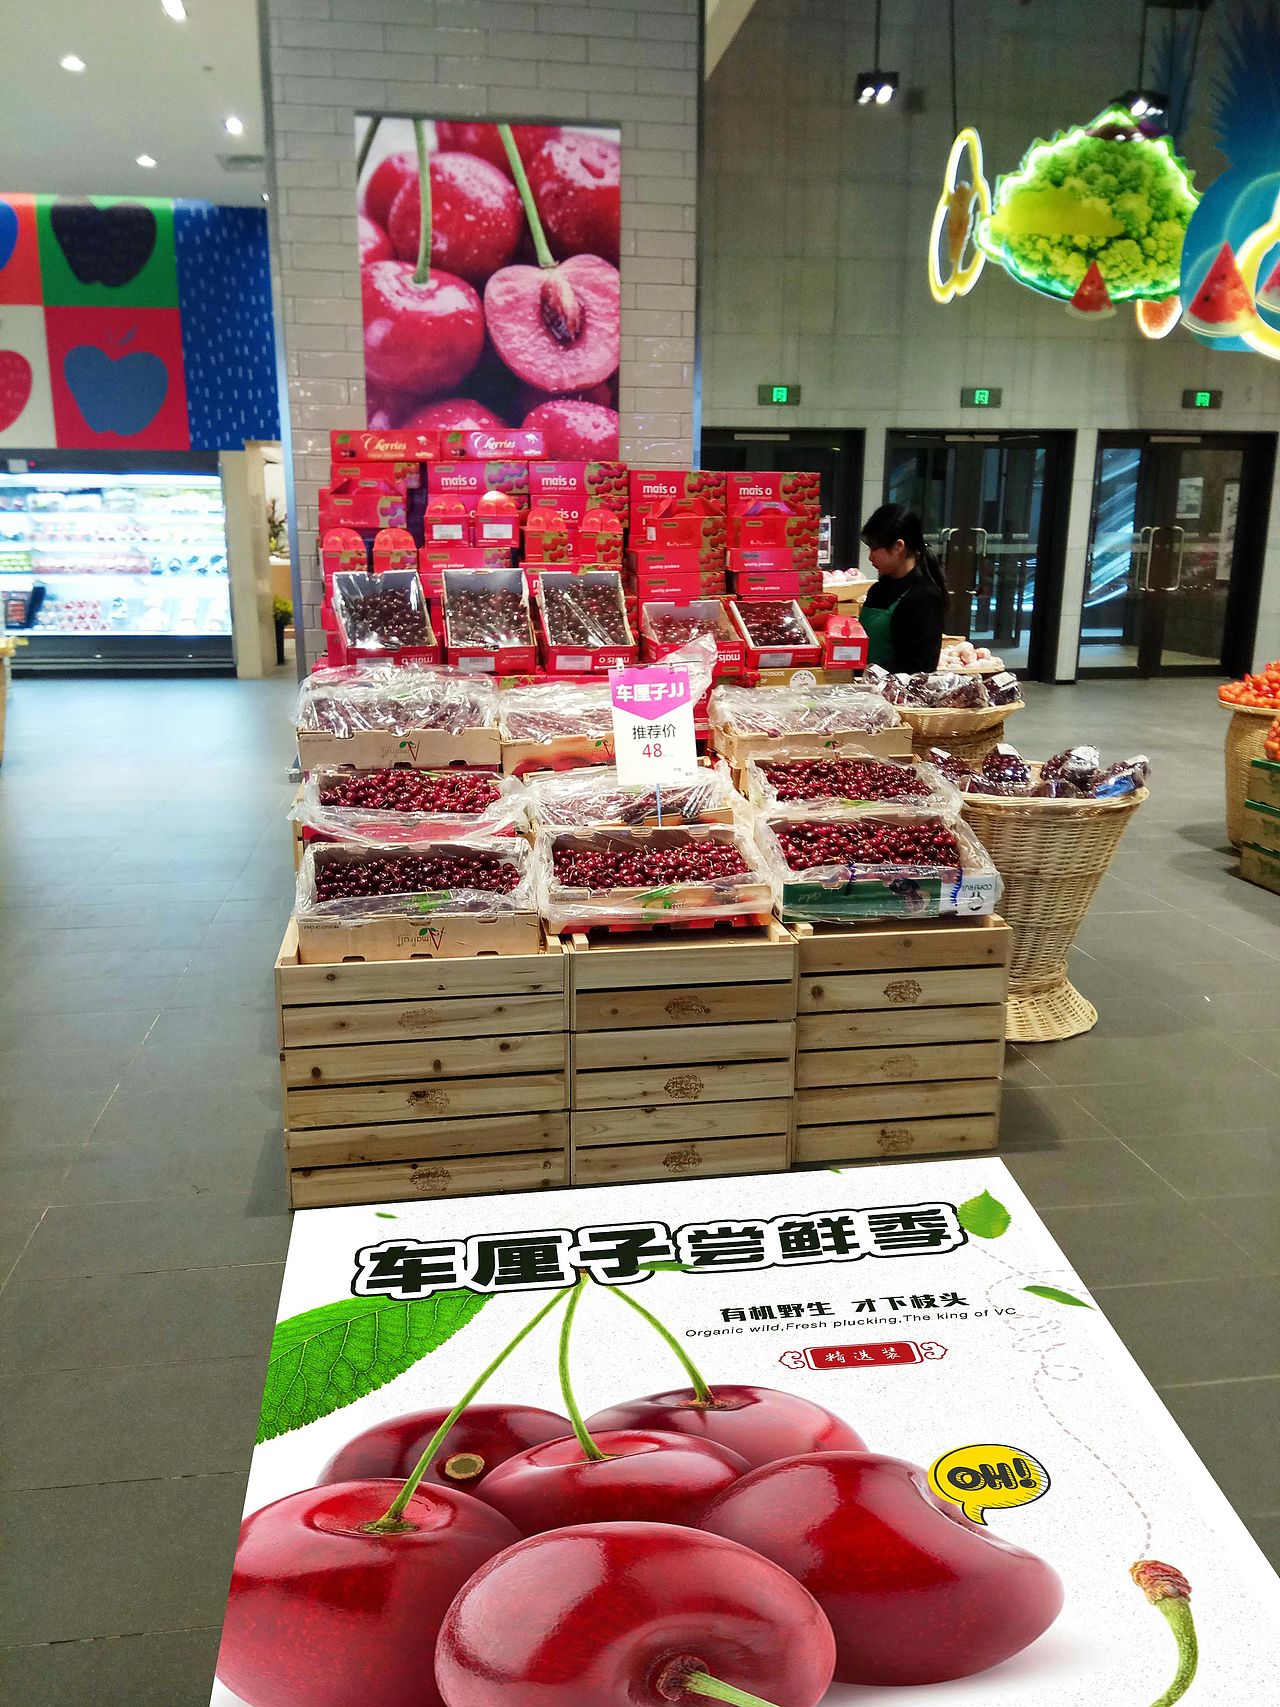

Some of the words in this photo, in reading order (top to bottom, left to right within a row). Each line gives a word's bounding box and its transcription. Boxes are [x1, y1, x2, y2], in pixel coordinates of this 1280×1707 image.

[360, 433, 407, 451] Cherries
[470, 432, 516, 450] Cherries
[441, 474, 467, 486] mais
[541, 475, 567, 486] mais
[642, 483, 668, 494] mais
[739, 484, 763, 495] mais
[615, 682, 685, 703] 车厘子JJ
[632, 723, 676, 740] 推荐价
[642, 743, 663, 758] 48
[357, 1206, 960, 1297] 车厘子尝鲜季
[720, 1301, 835, 1322] 有机野生
[851, 1292, 970, 1313] 才下枝头
[685, 1327, 743, 1338] Organic
[937, 1311, 967, 1320] king
[974, 1309, 989, 1317] of
[995, 1307, 1017, 1316] VC
[824, 1347, 900, 1363] 精选装
[947, 1457, 1036, 1491] OH!
